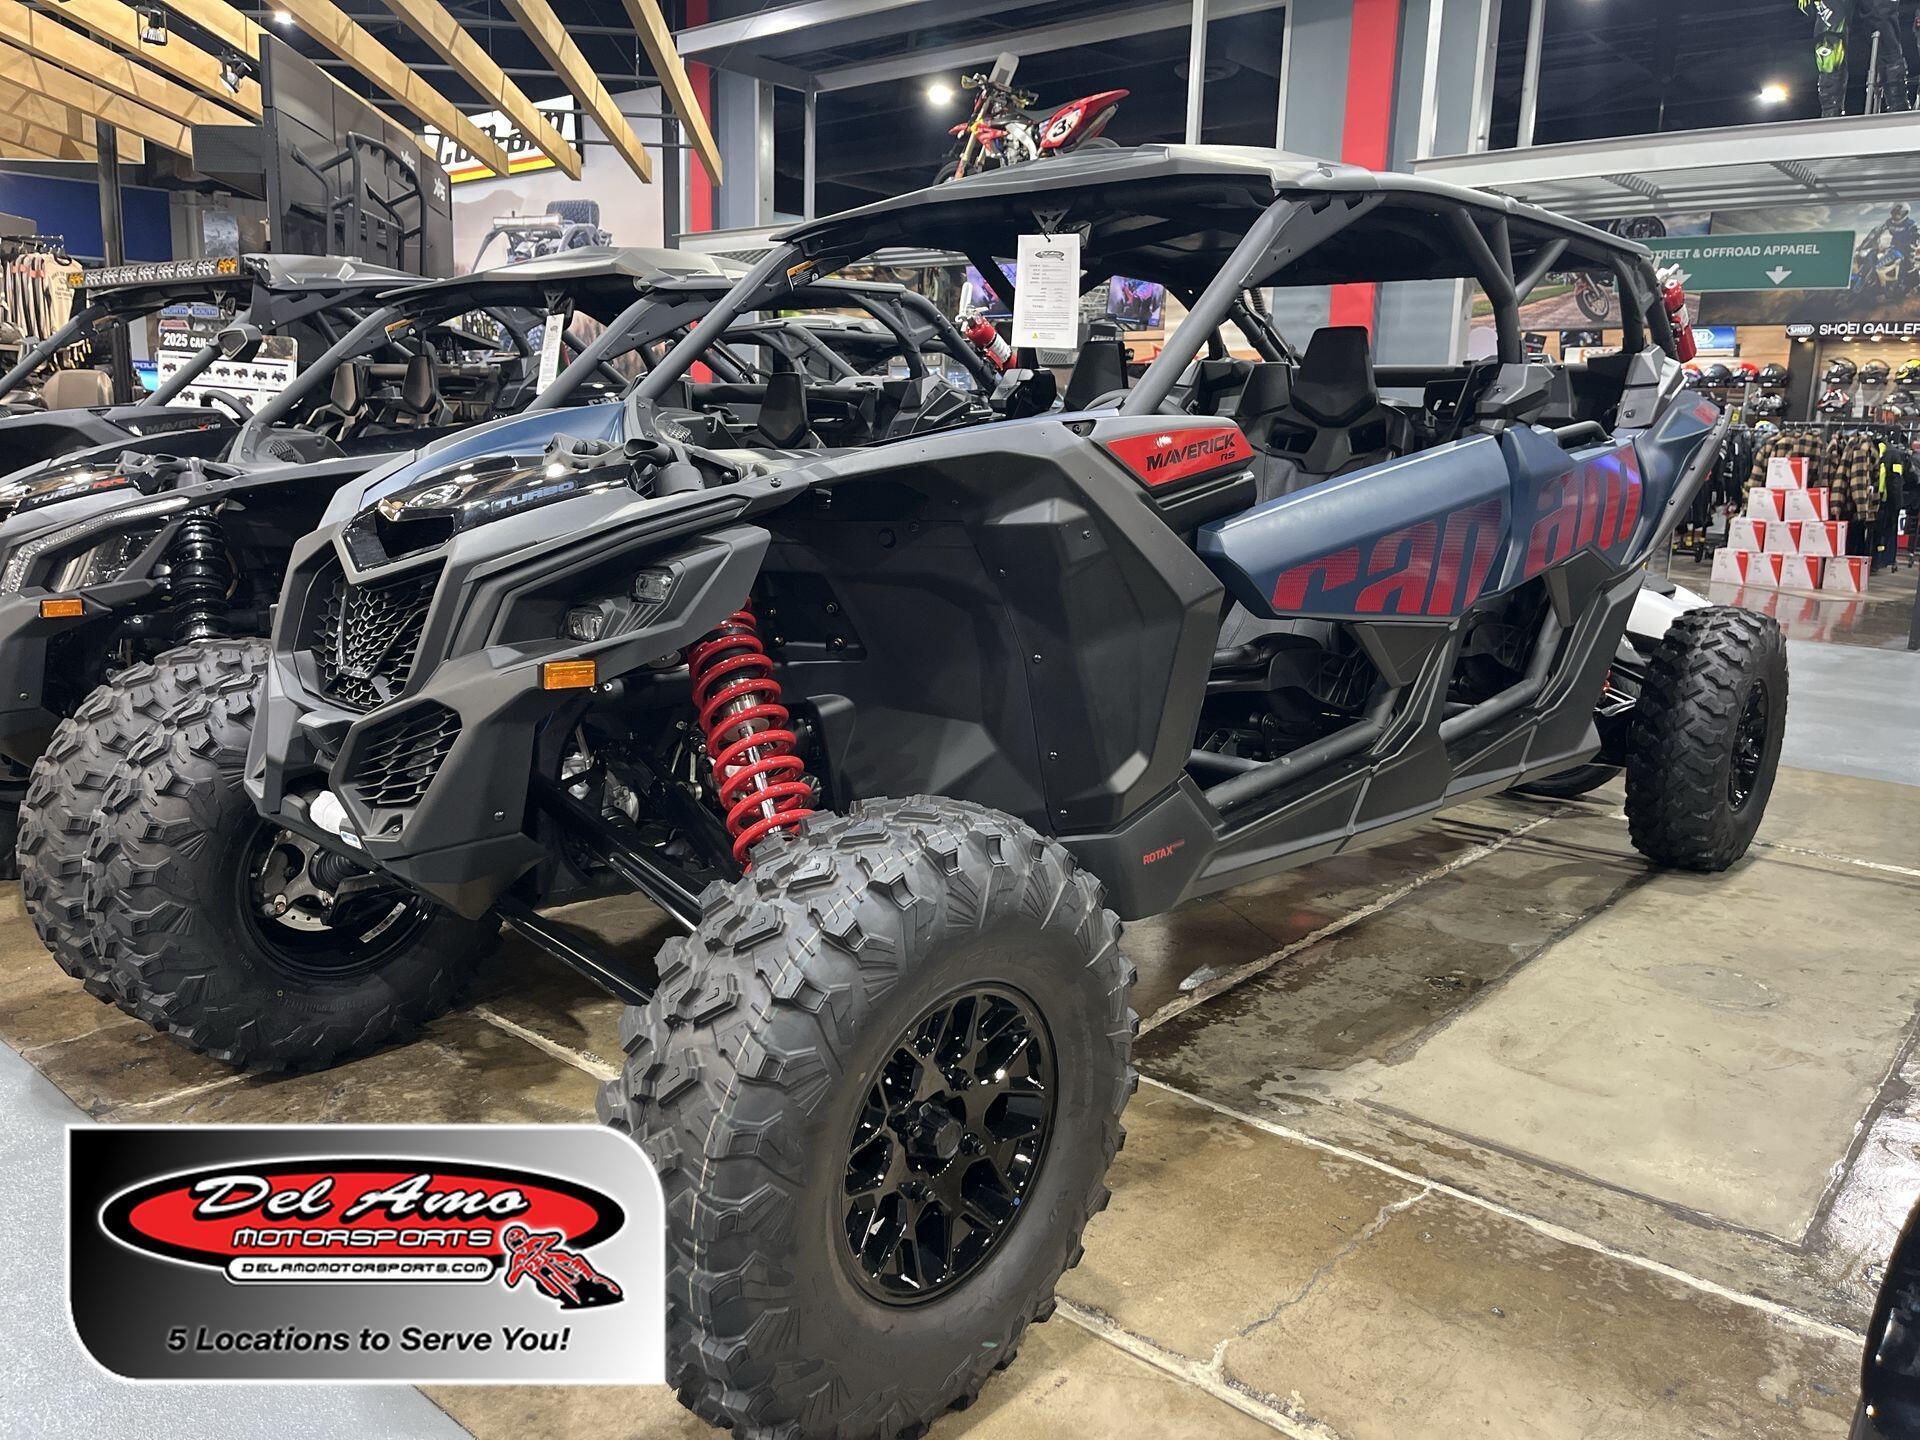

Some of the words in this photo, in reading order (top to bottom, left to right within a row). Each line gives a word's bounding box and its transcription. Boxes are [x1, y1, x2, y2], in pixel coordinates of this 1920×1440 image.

[1692, 250, 1700, 259] &
[1703, 246, 1761, 259] OFFROAD
[1763, 244, 1820, 256] APPAREL
[1819, 323, 1860, 336] SHOEI
[163, 332, 188, 347] 2025
[190, 336, 212, 348] CAN-
[1146, 433, 1236, 471] MAVERICK
[31, 485, 90, 504] TURBO
[494, 481, 577, 510] TURBO
[1143, 845, 1173, 865] ROTAX
